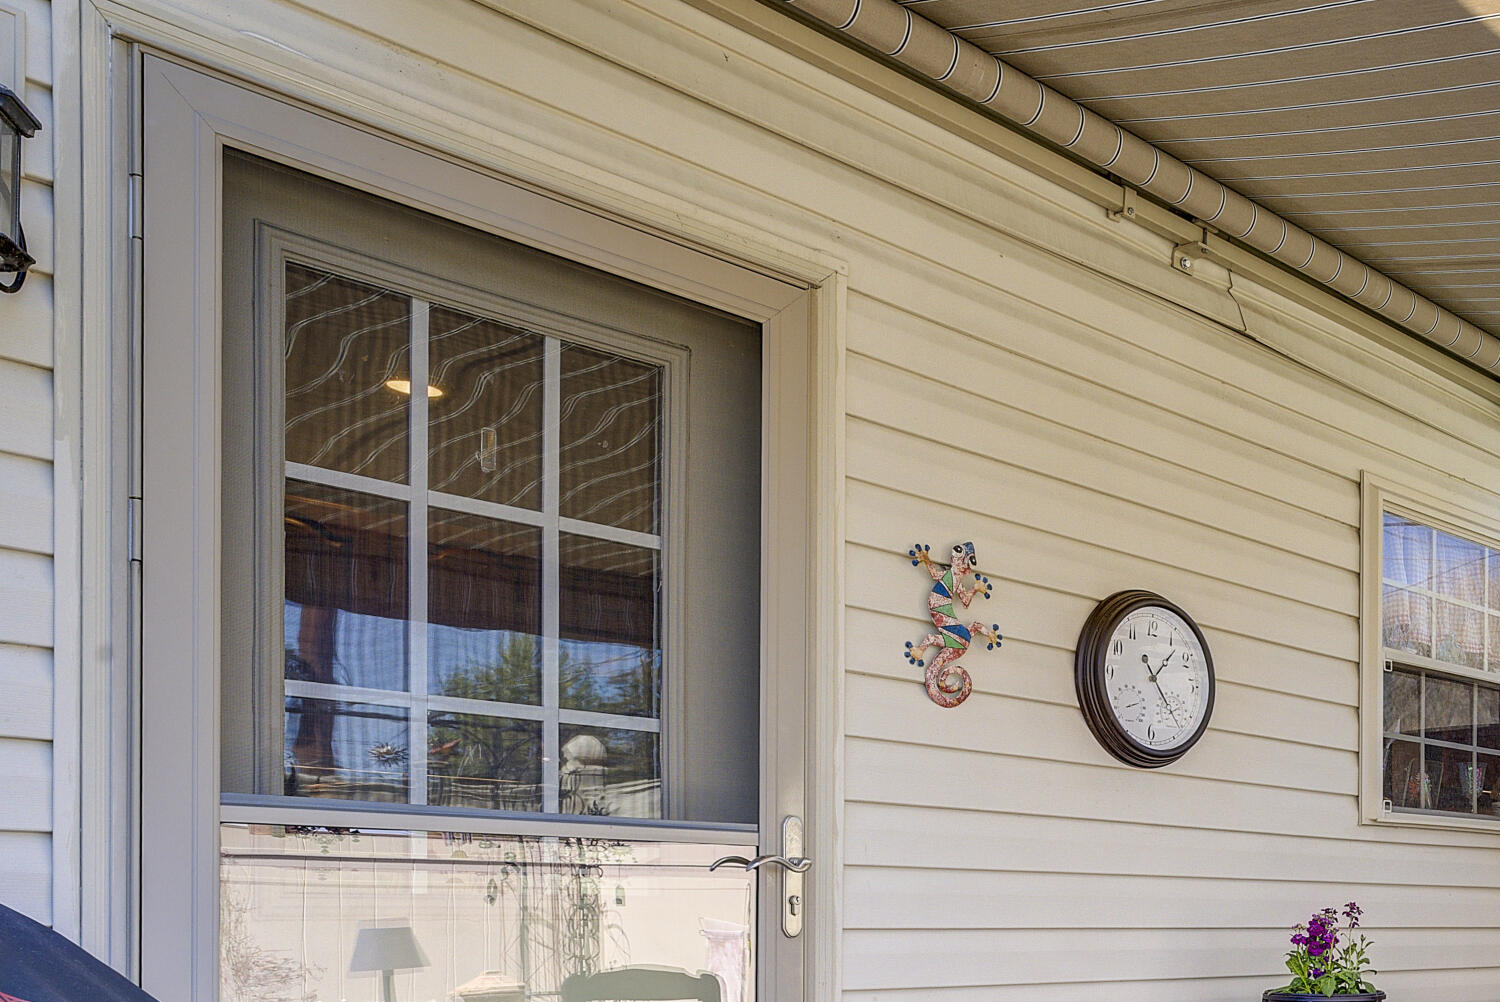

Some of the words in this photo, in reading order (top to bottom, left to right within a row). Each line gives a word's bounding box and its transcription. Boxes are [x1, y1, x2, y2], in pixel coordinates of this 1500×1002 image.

[1129, 623, 1136, 640] 11
[1146, 620, 1158, 637] 12
[1113, 639, 1123, 656] 10
[1106, 664, 1114, 680] 9
[1147, 723, 1156, 741] 6
